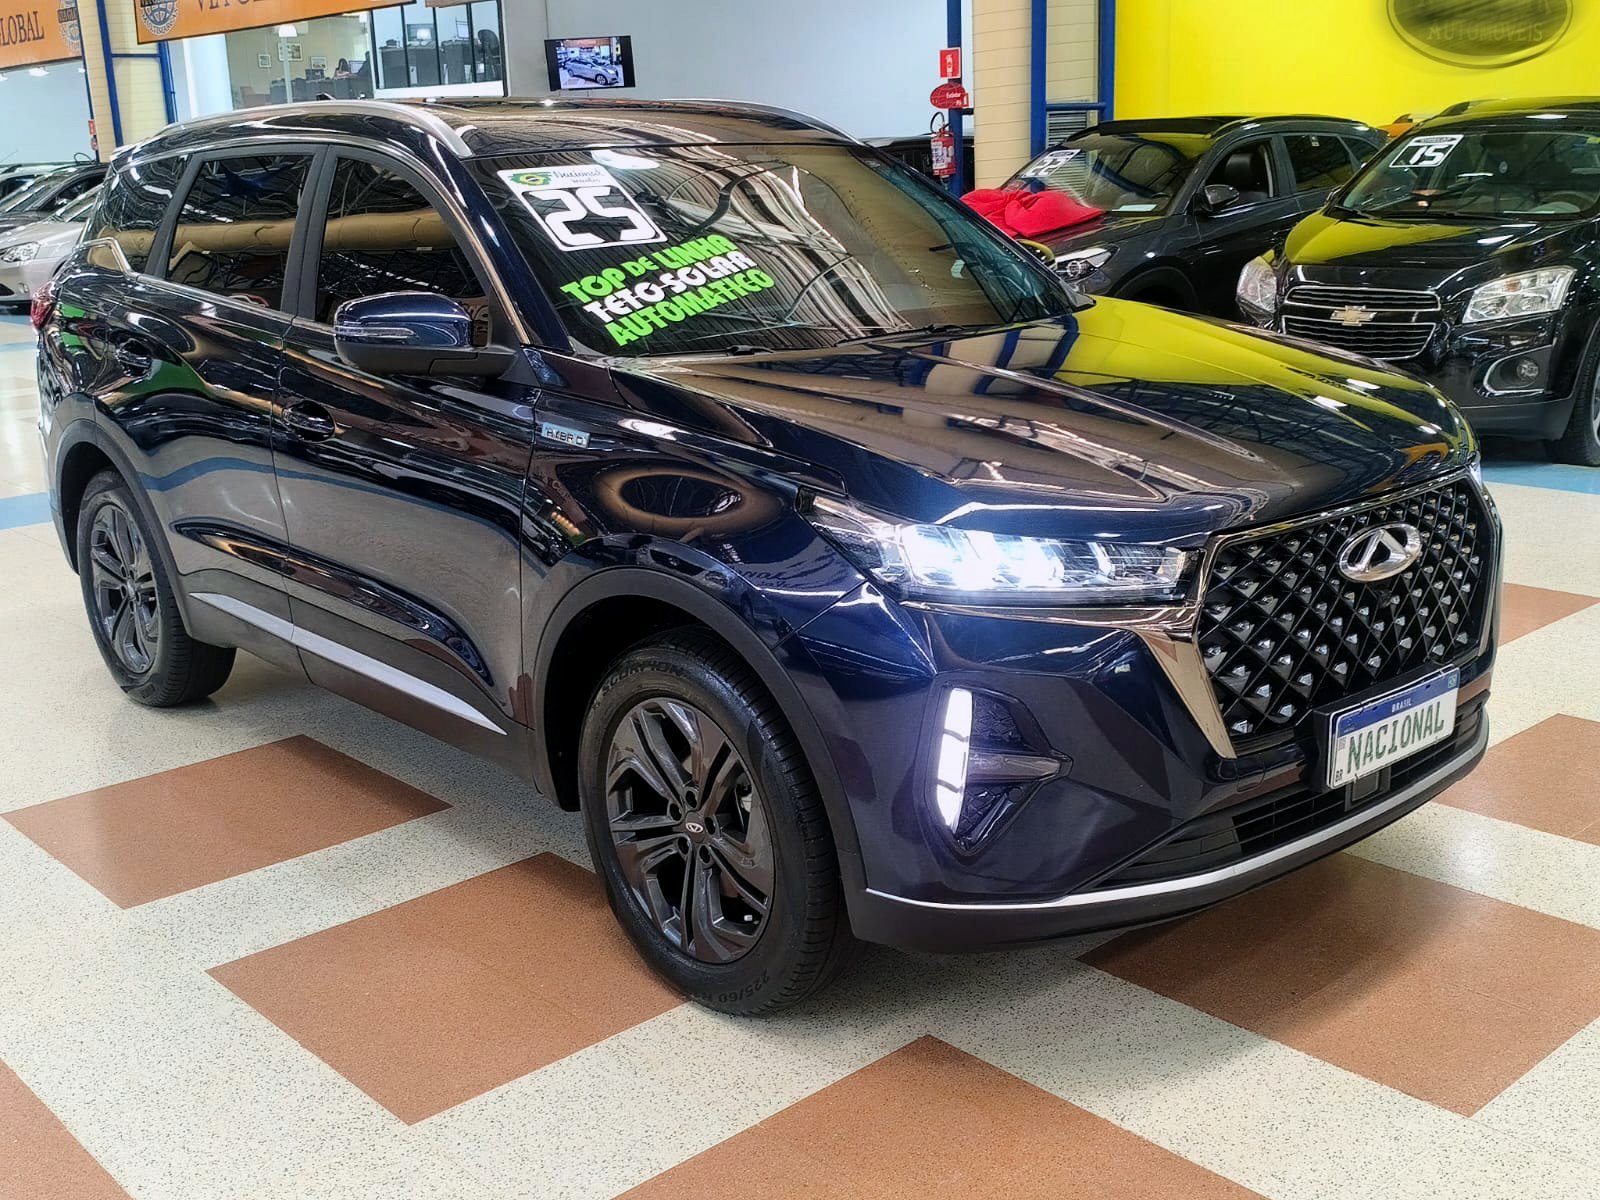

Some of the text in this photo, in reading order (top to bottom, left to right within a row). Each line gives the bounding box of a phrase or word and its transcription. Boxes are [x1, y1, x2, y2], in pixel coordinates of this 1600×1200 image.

[0, 11, 45, 46] LOBAL
[528, 186, 656, 246] 25
[560, 234, 738, 304] TOP DE LINHA
[582, 251, 758, 322] TETO SOLAR
[604, 269, 776, 347] AUTOMATICO
[545, 426, 584, 445] HYBRD
[1347, 701, 1445, 775] NACIONAL
